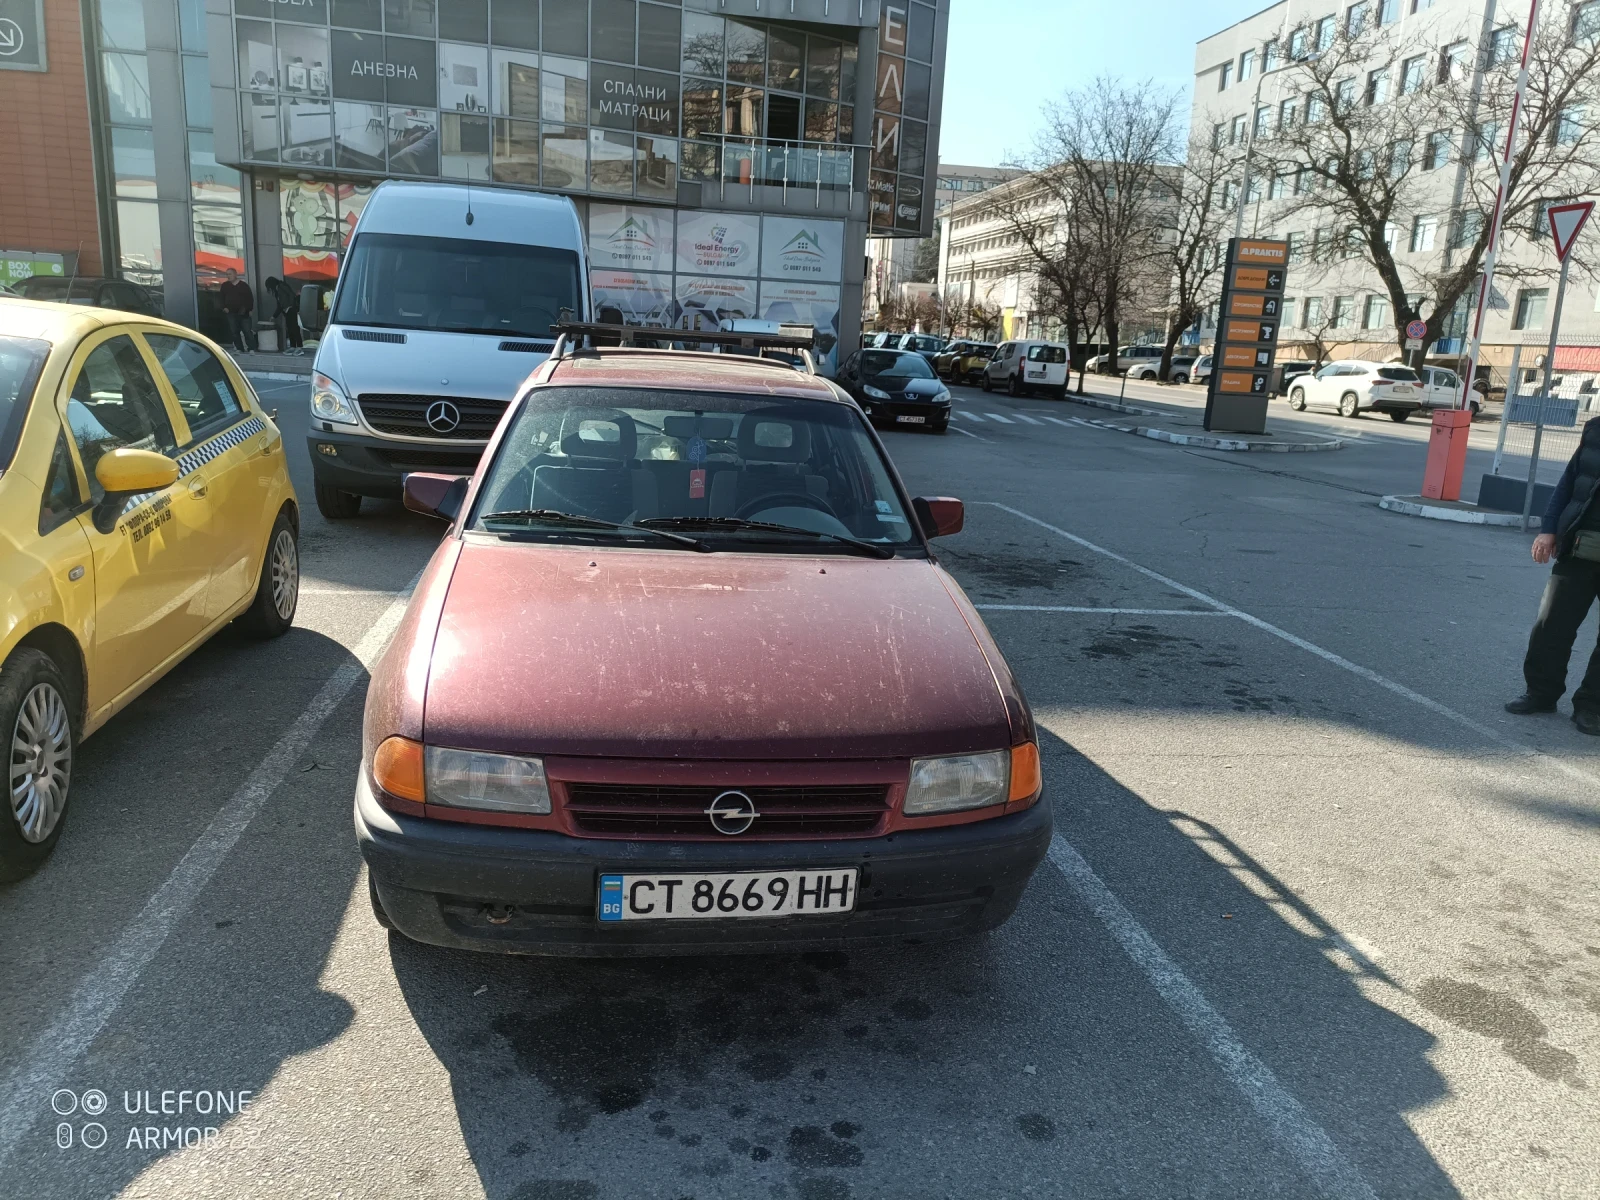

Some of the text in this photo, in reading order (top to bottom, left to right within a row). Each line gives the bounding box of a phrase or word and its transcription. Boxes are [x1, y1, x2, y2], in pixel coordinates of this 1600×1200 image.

[350, 59, 418, 80] ДНЕВНА
[603, 79, 666, 101] СПАЛНИ
[599, 99, 670, 123] МАТРАЦИ
[694, 243, 739, 254] Ideal Energy
[1249, 247, 1284, 258] PRAKTIS
[8, 261, 31, 271] BOX
[9, 269, 33, 278] NOW
[629, 874, 849, 914] CT 8669 HH
[603, 903, 620, 914] BG
